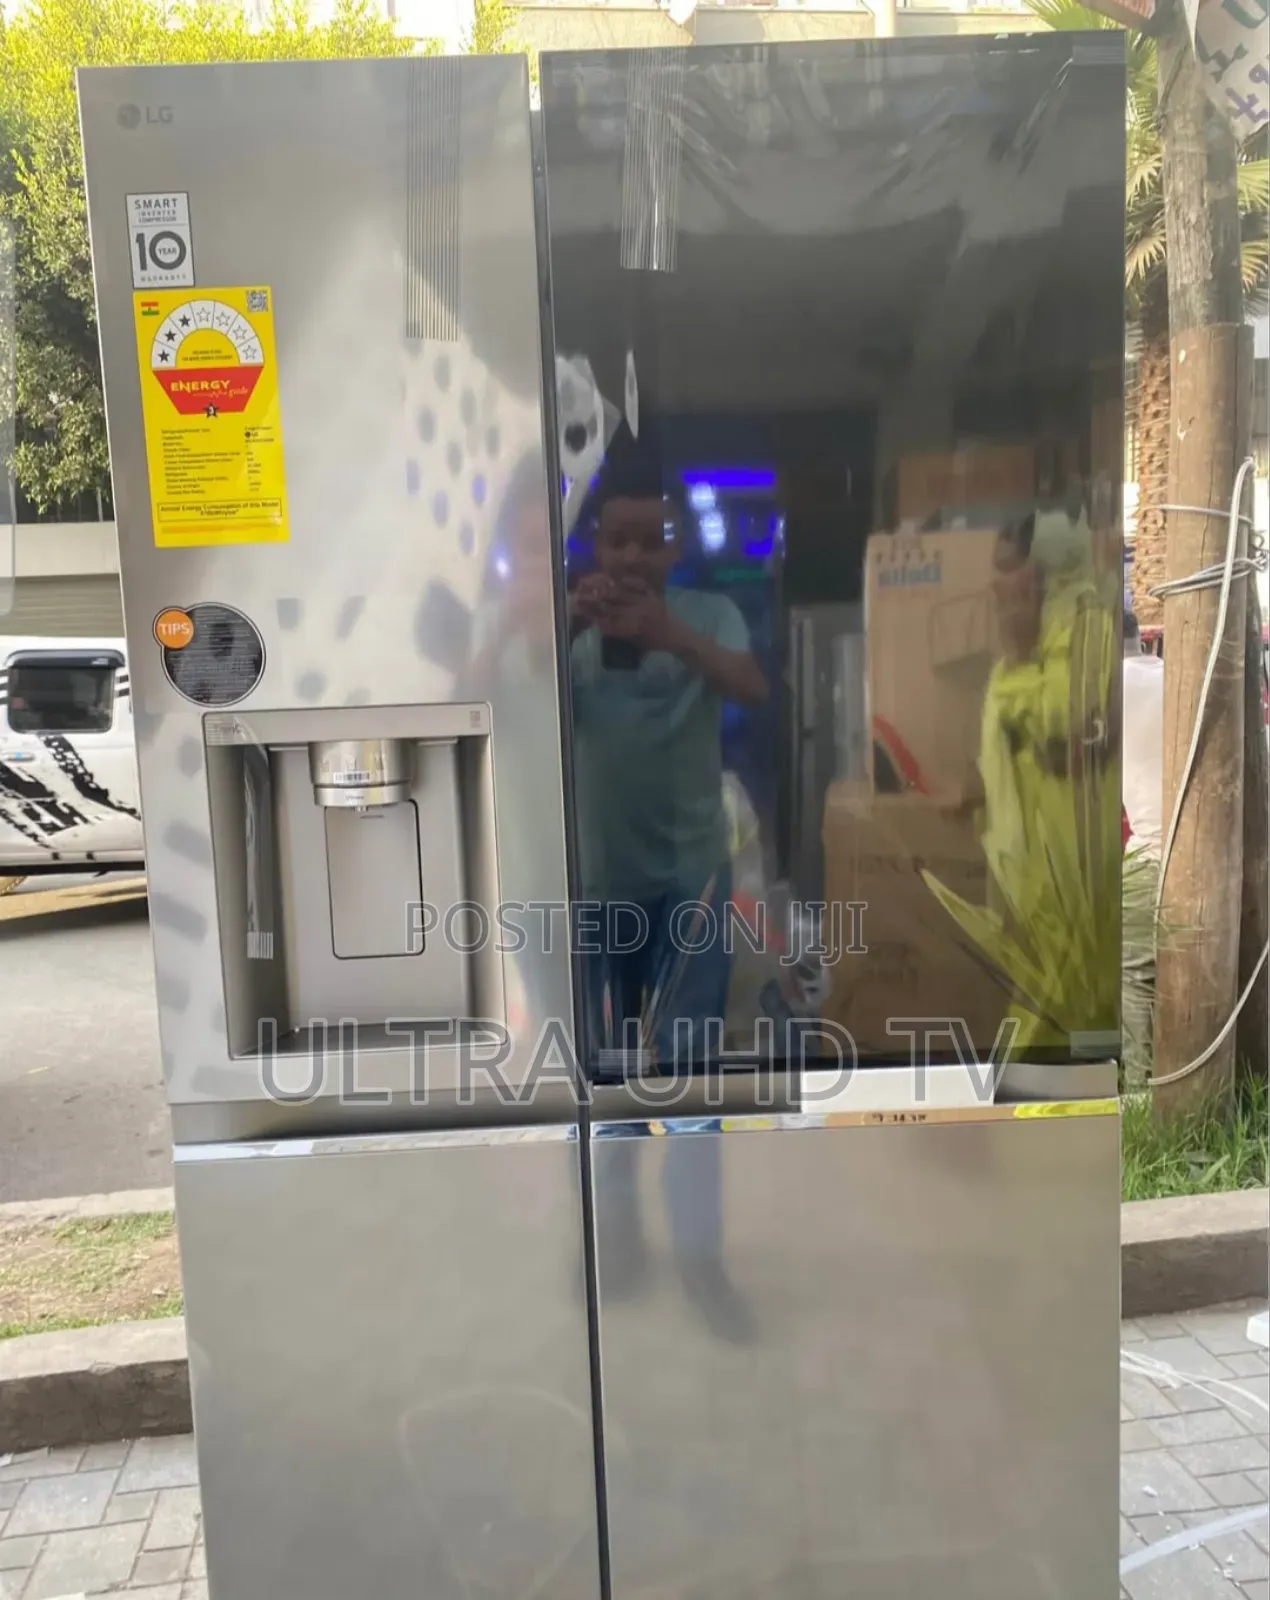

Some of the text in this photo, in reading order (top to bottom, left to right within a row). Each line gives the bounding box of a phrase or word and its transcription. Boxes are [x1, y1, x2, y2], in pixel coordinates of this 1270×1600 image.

[146, 105, 173, 124] LG
[134, 198, 178, 209] SMART
[135, 230, 187, 271] 10
[158, 247, 177, 255] YEAR
[170, 379, 231, 394] ENERGY
[160, 622, 190, 636] TIPS
